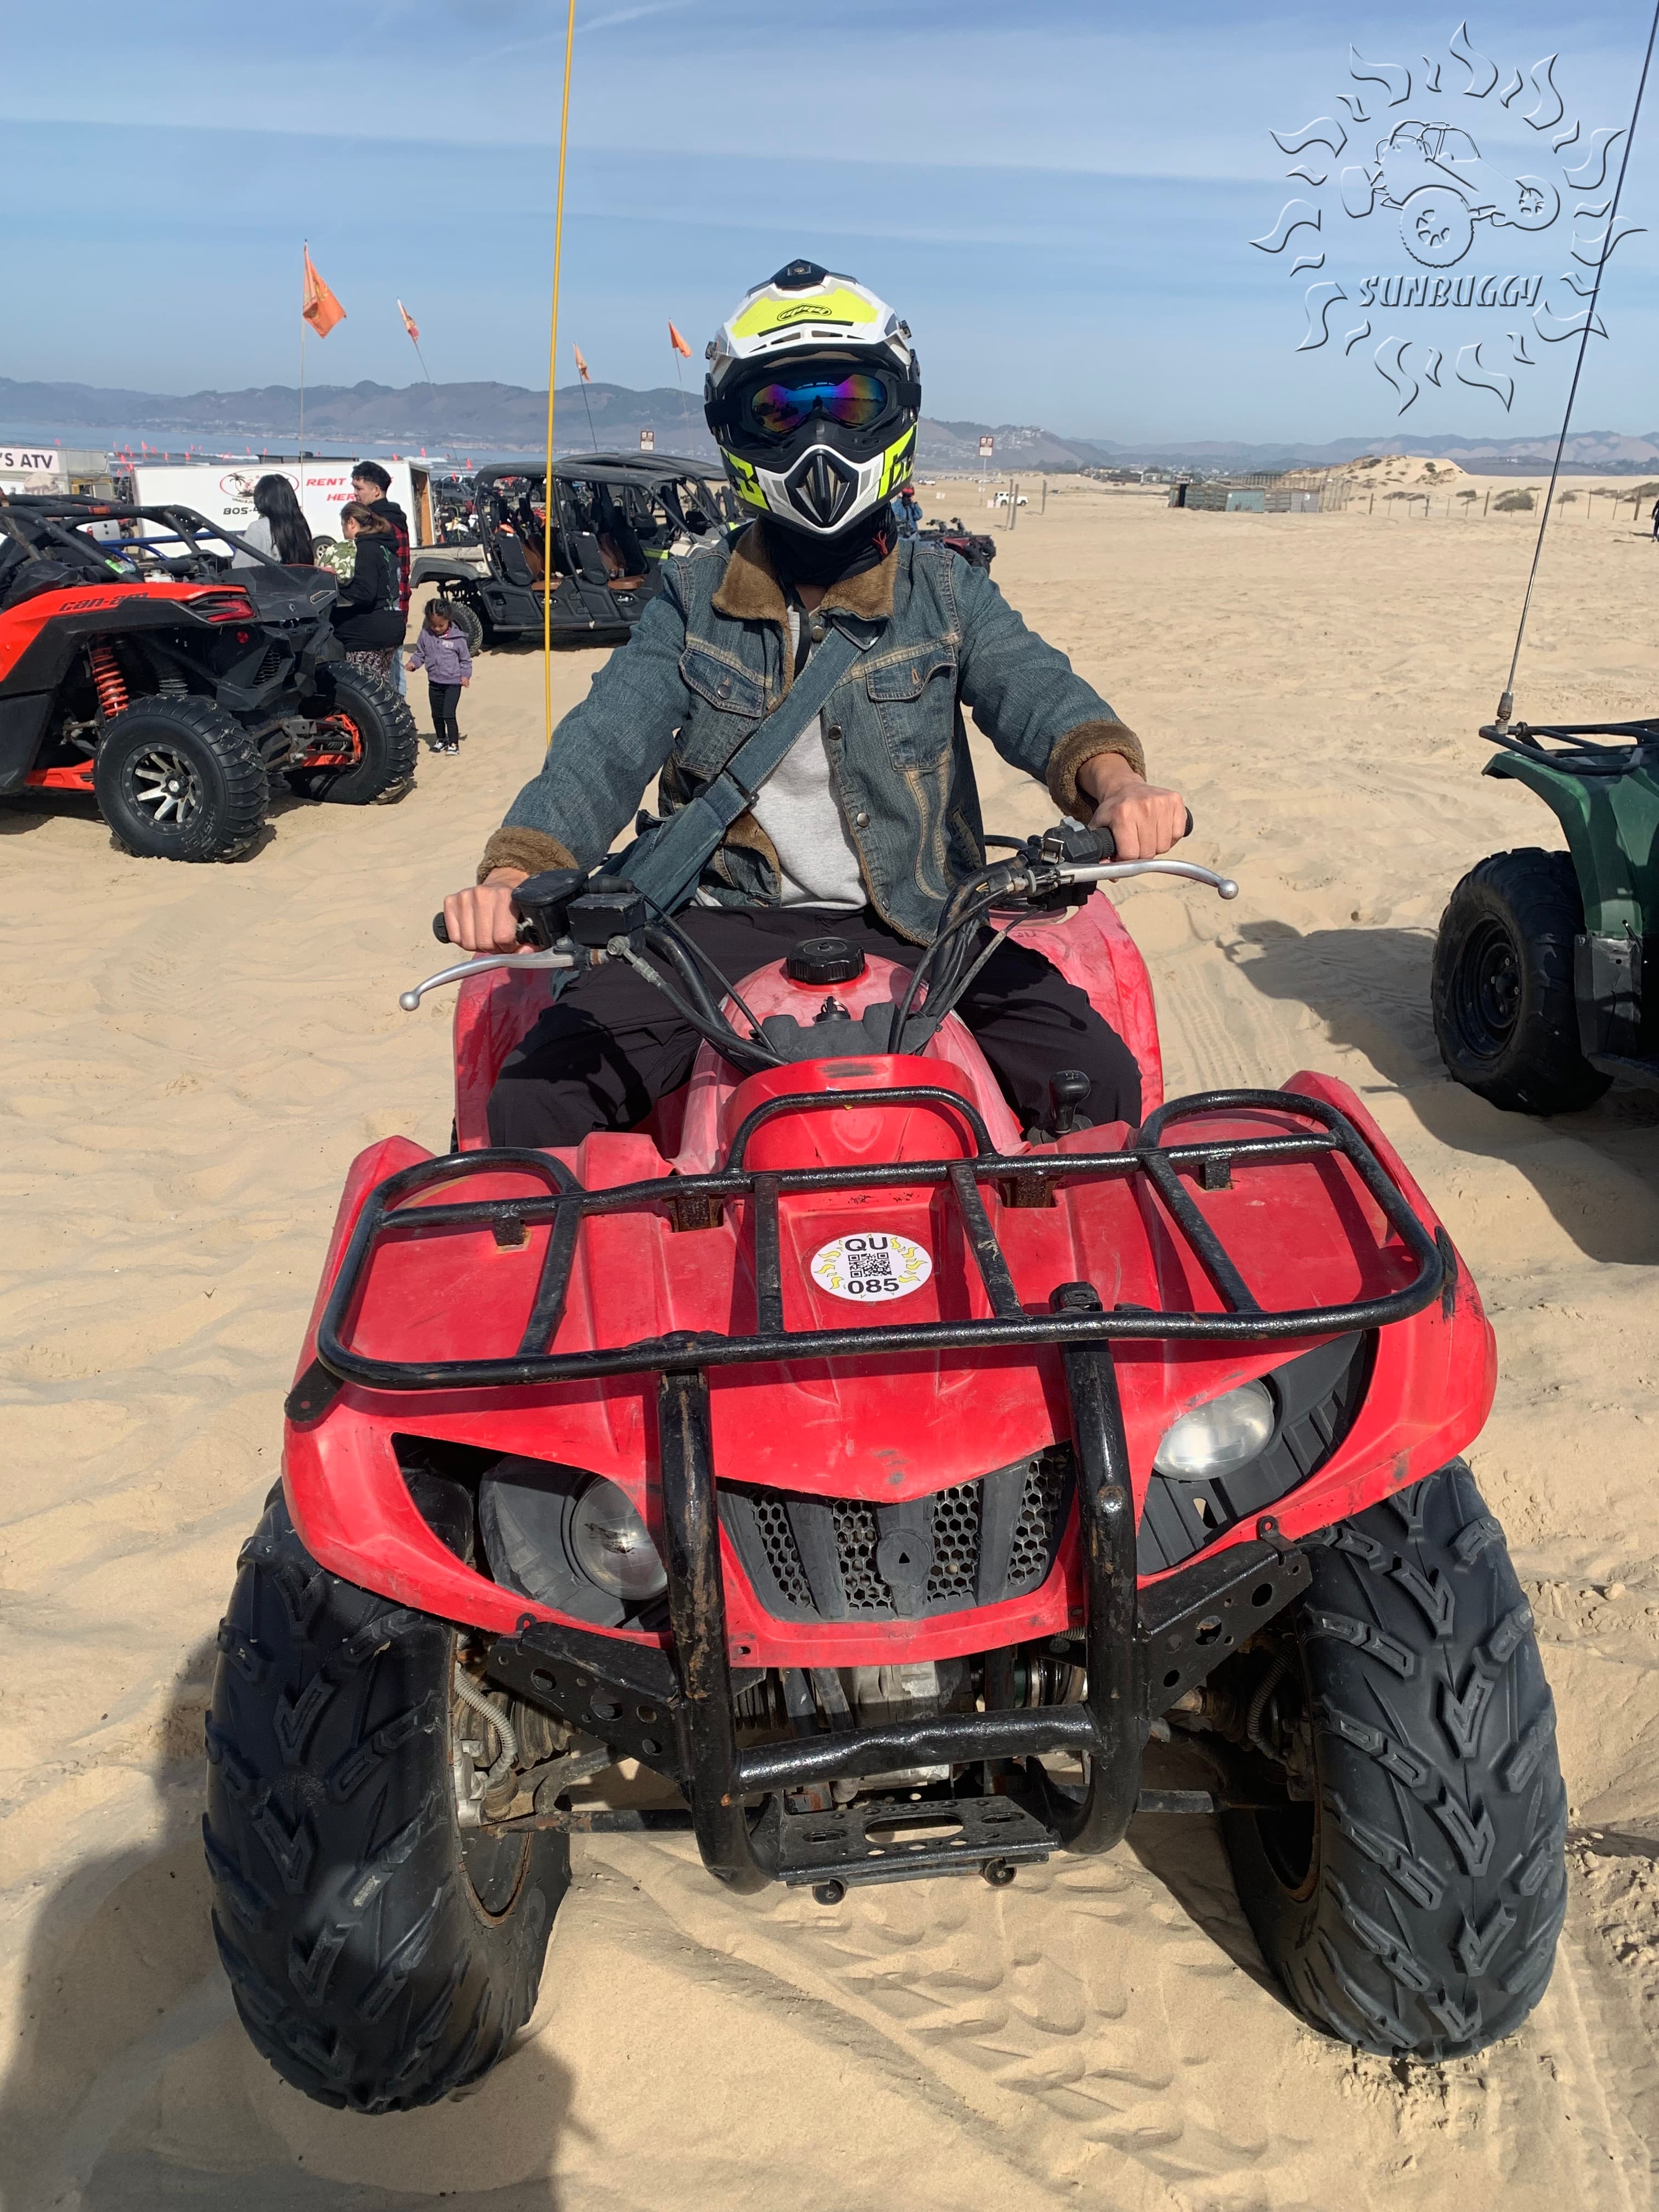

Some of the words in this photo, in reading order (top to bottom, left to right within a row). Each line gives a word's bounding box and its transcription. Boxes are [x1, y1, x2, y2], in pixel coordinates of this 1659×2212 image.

[20, 453, 53, 469] ATV
[306, 478, 346, 487] RENT
[326, 493, 357, 501] HER
[844, 1237, 888, 1252] QU
[847, 1278, 900, 1295] 085
